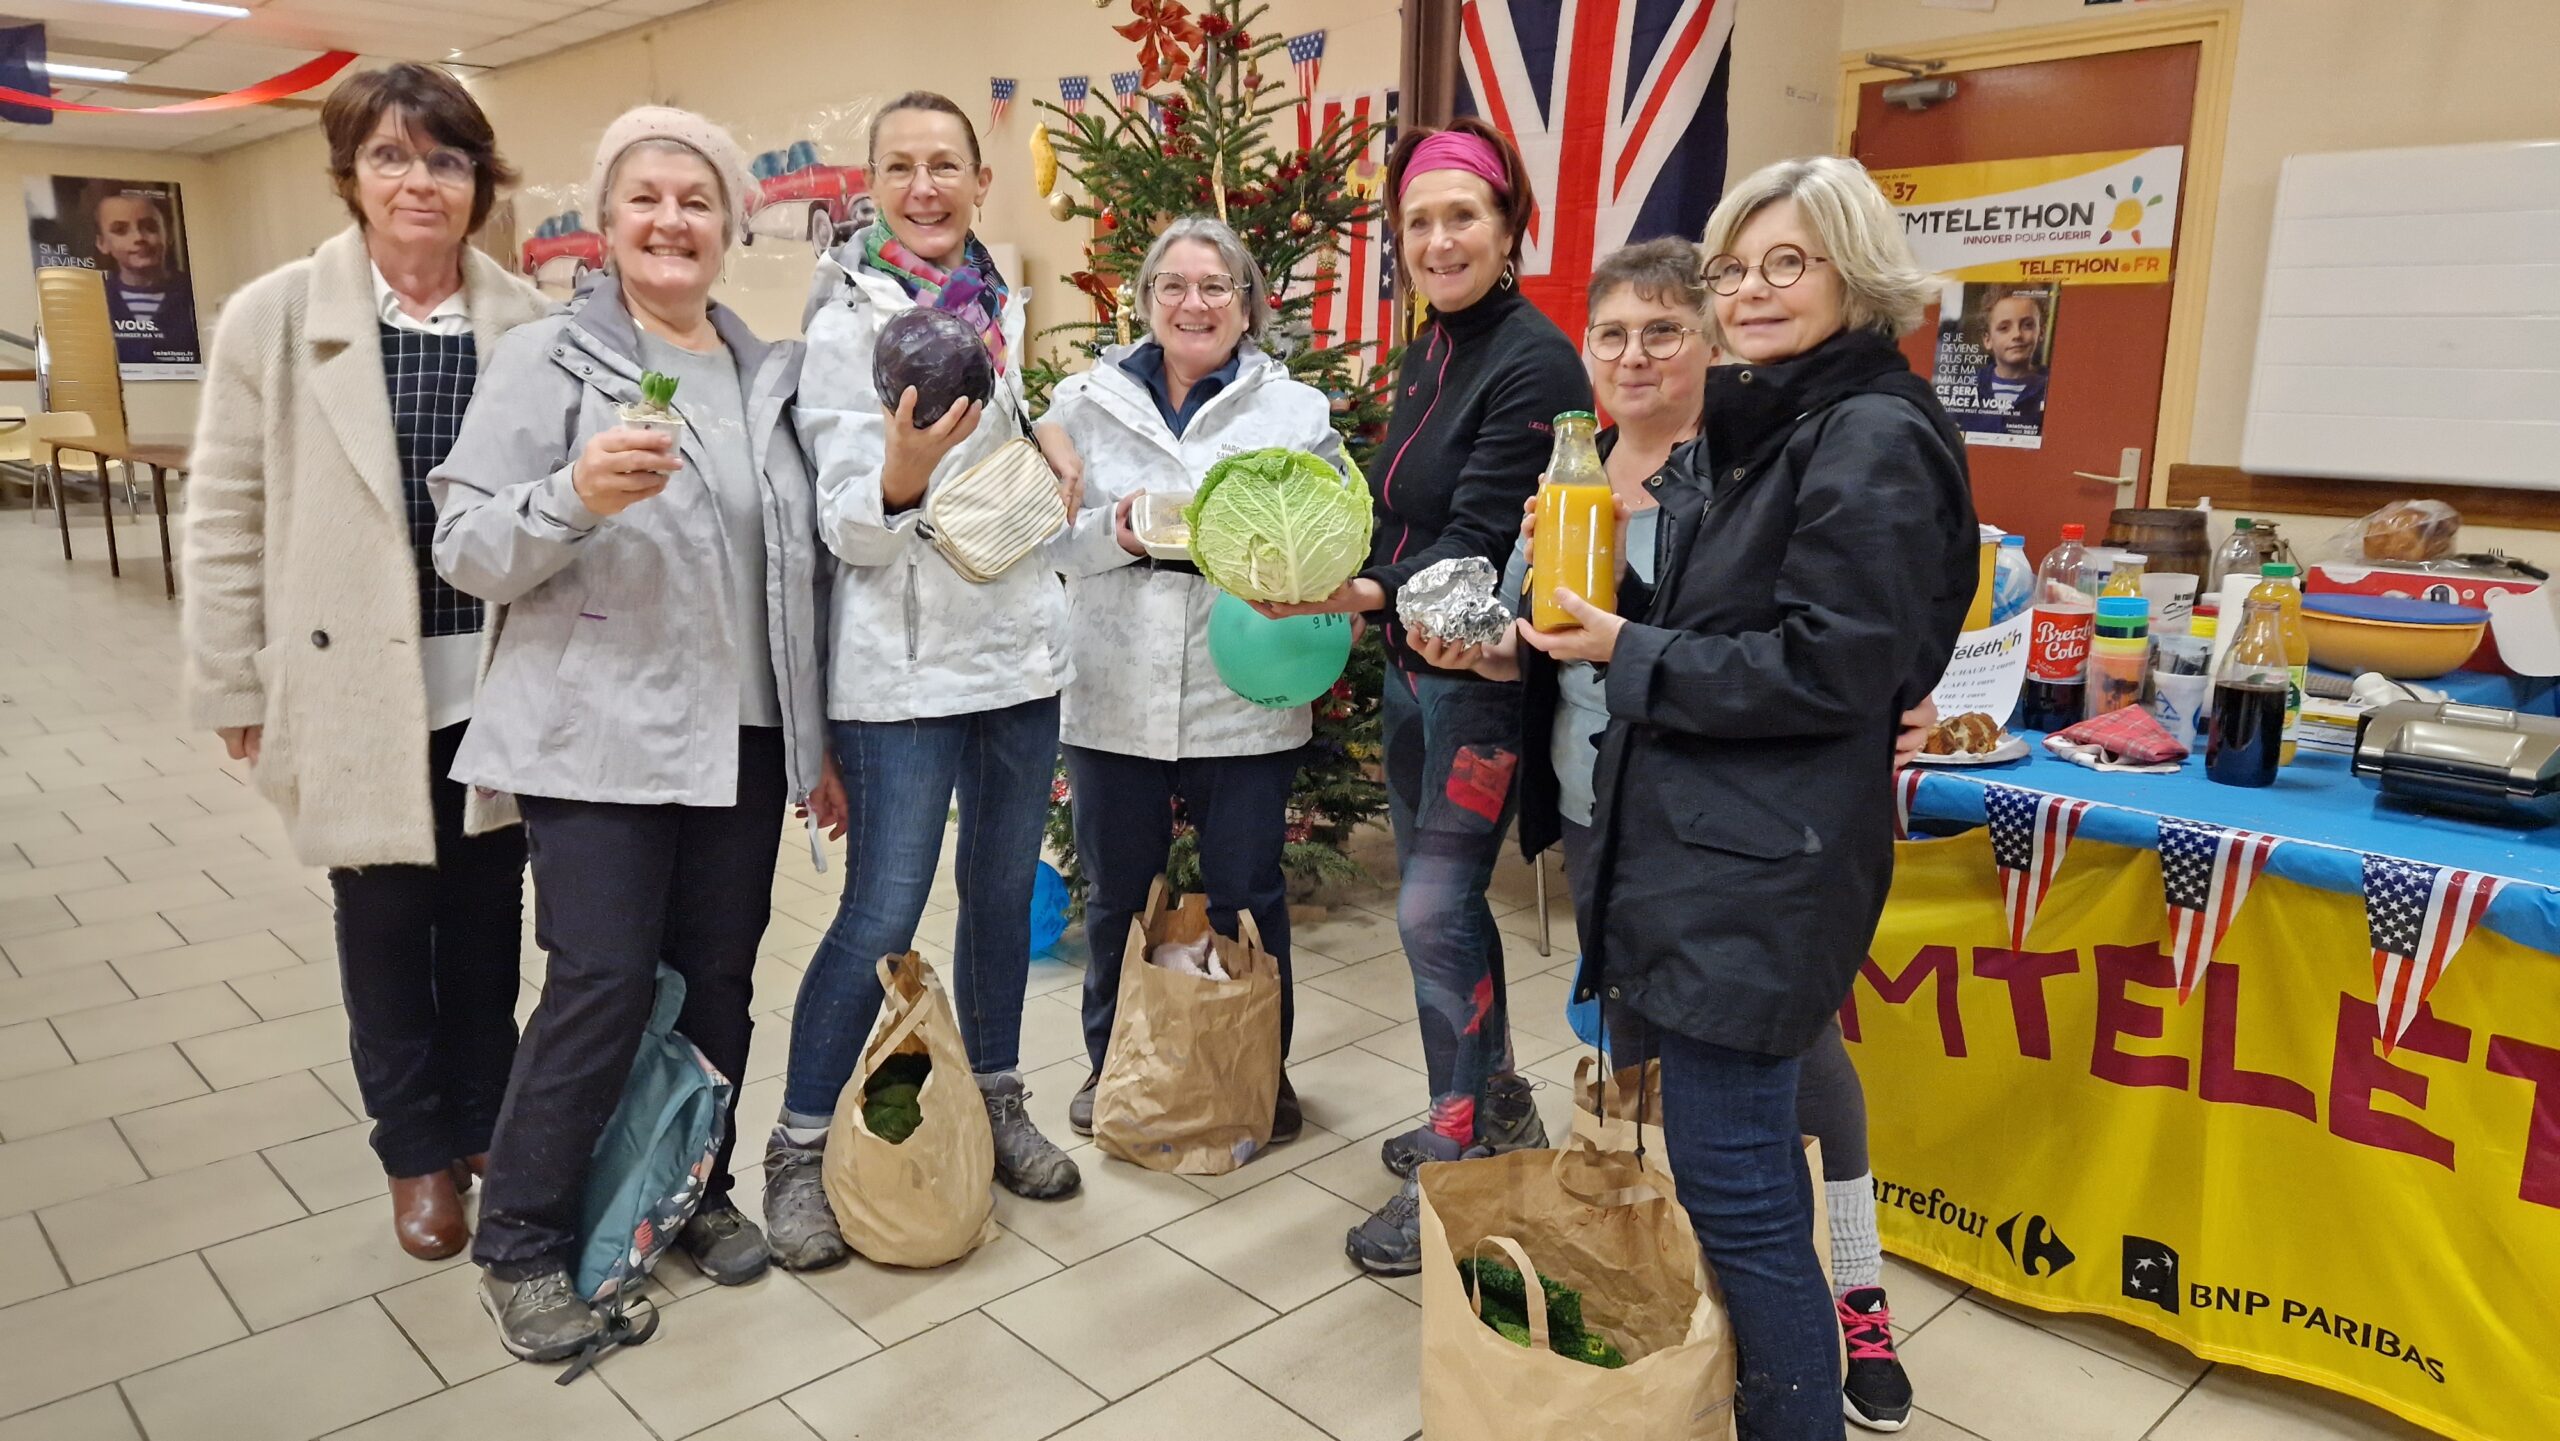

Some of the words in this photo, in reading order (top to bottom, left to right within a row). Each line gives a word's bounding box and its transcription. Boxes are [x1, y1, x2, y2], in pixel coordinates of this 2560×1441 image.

[1893, 181, 1918, 202] 37
[1962, 234, 2012, 245] INNOVER
[2014, 231, 2047, 243] POUR
[39, 243, 52, 255] SI
[54, 243, 69, 255] JE
[40, 255, 96, 268] DEVIENS
[114, 319, 159, 332] VOUS.
[1942, 332, 1951, 343] SI
[1954, 332, 1965, 343] JE
[1941, 343, 1980, 354] DEVIENS
[1940, 354, 1962, 364] PLUS
[1963, 354, 1989, 365] FORT
[1938, 364, 1959, 375] QUE
[1960, 365, 1976, 375] MA
[1937, 375, 1979, 386] MALADIE,
[1936, 385, 1951, 395] CE
[1952, 386, 1979, 397] SERA
[1982, 399, 2015, 410] VOUS.
[2035, 619, 2093, 644] Breizh
[1954, 629, 2022, 661] éléthon
[2045, 641, 2085, 661] Cola
[2189, 1282, 2271, 1316] BNP
[2281, 1298, 2446, 1384] PARIBAS
